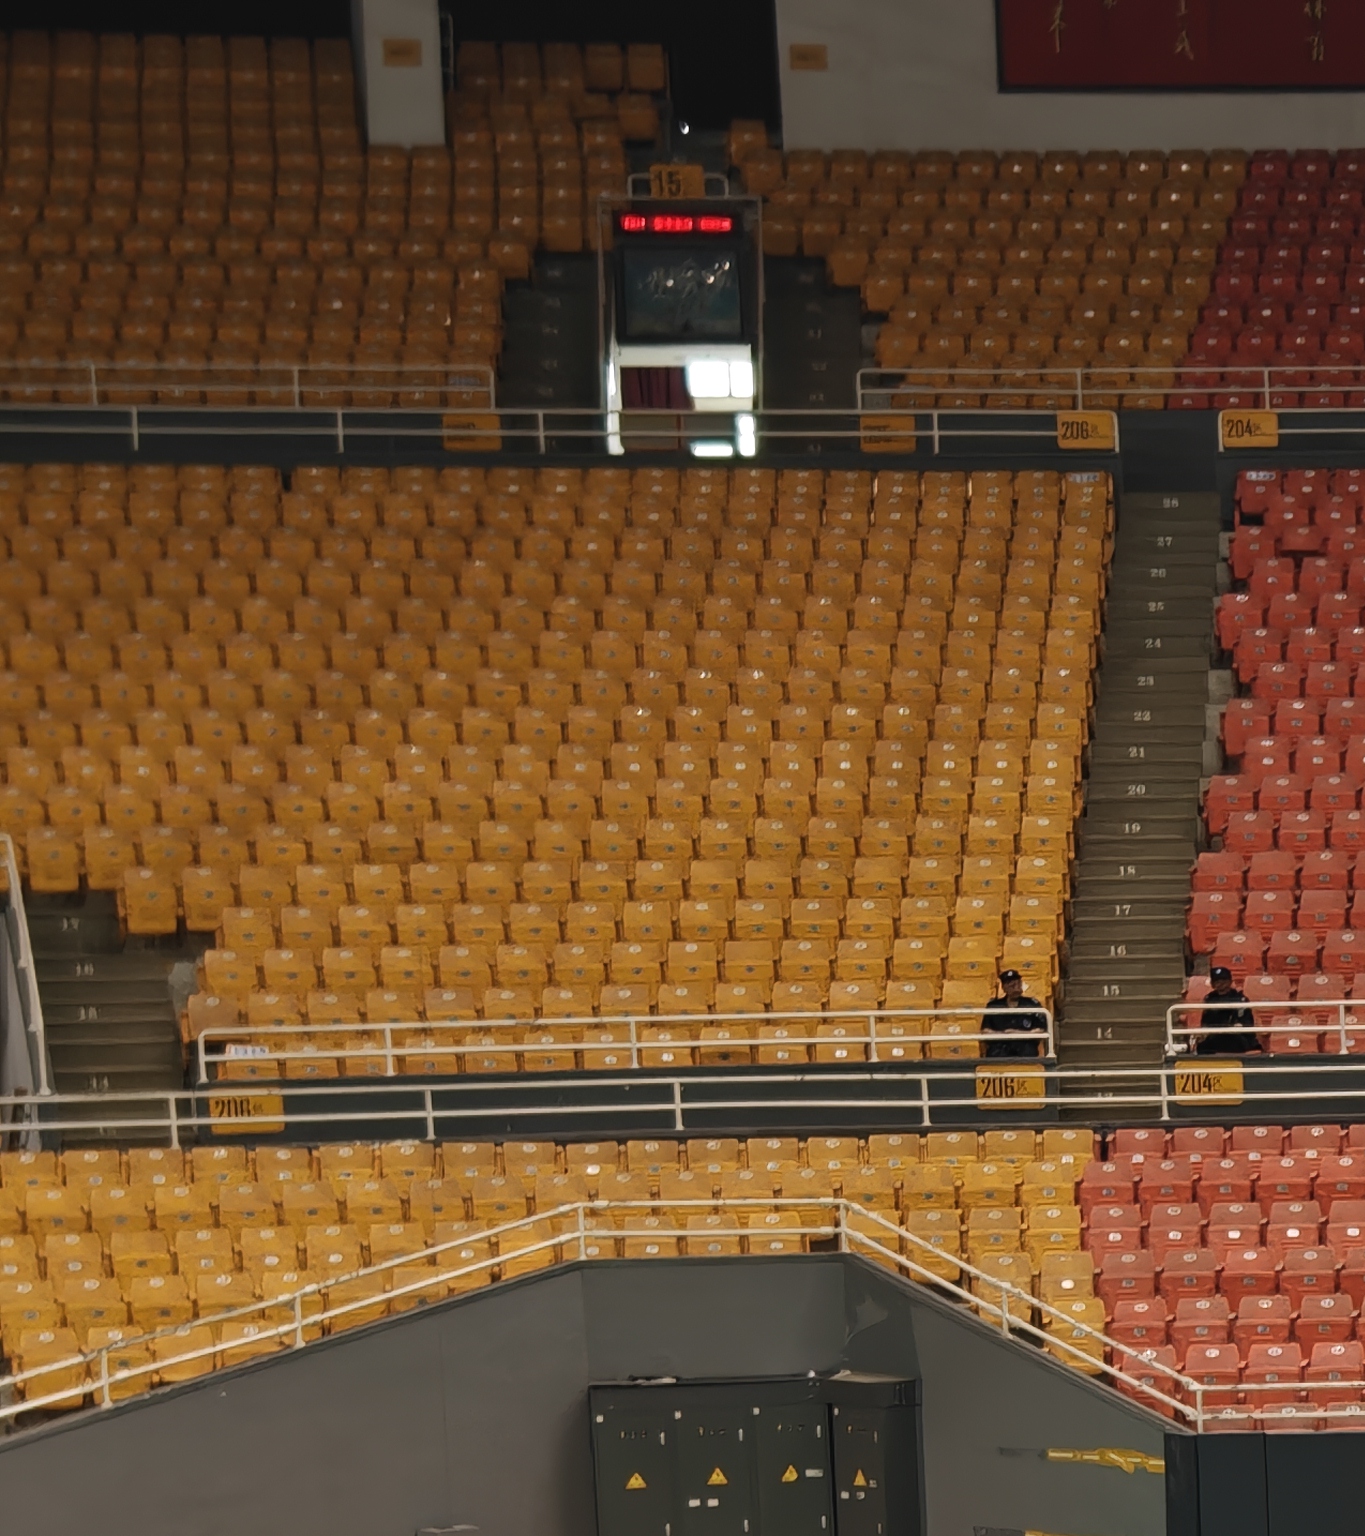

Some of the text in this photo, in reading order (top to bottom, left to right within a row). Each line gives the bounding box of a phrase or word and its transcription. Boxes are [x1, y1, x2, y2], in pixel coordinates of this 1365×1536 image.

[653, 170, 681, 197] 15
[1061, 420, 1088, 440] 206
[1226, 419, 1253, 438] 204
[1157, 536, 1173, 546] 27
[1150, 568, 1167, 578] 26
[1144, 638, 1162, 649] 24
[1137, 676, 1155, 686] 23
[1133, 710, 1151, 721] 22
[1128, 746, 1145, 758] 21
[1128, 784, 1146, 795] 20
[1123, 823, 1141, 834] 19
[1118, 866, 1136, 876] 18
[1114, 904, 1131, 915] 17
[1109, 945, 1127, 956] 16
[1102, 985, 1120, 996] 15
[1096, 1027, 1113, 1039] 14
[981, 1077, 1015, 1099] 206
[1180, 1073, 1212, 1094] 204
